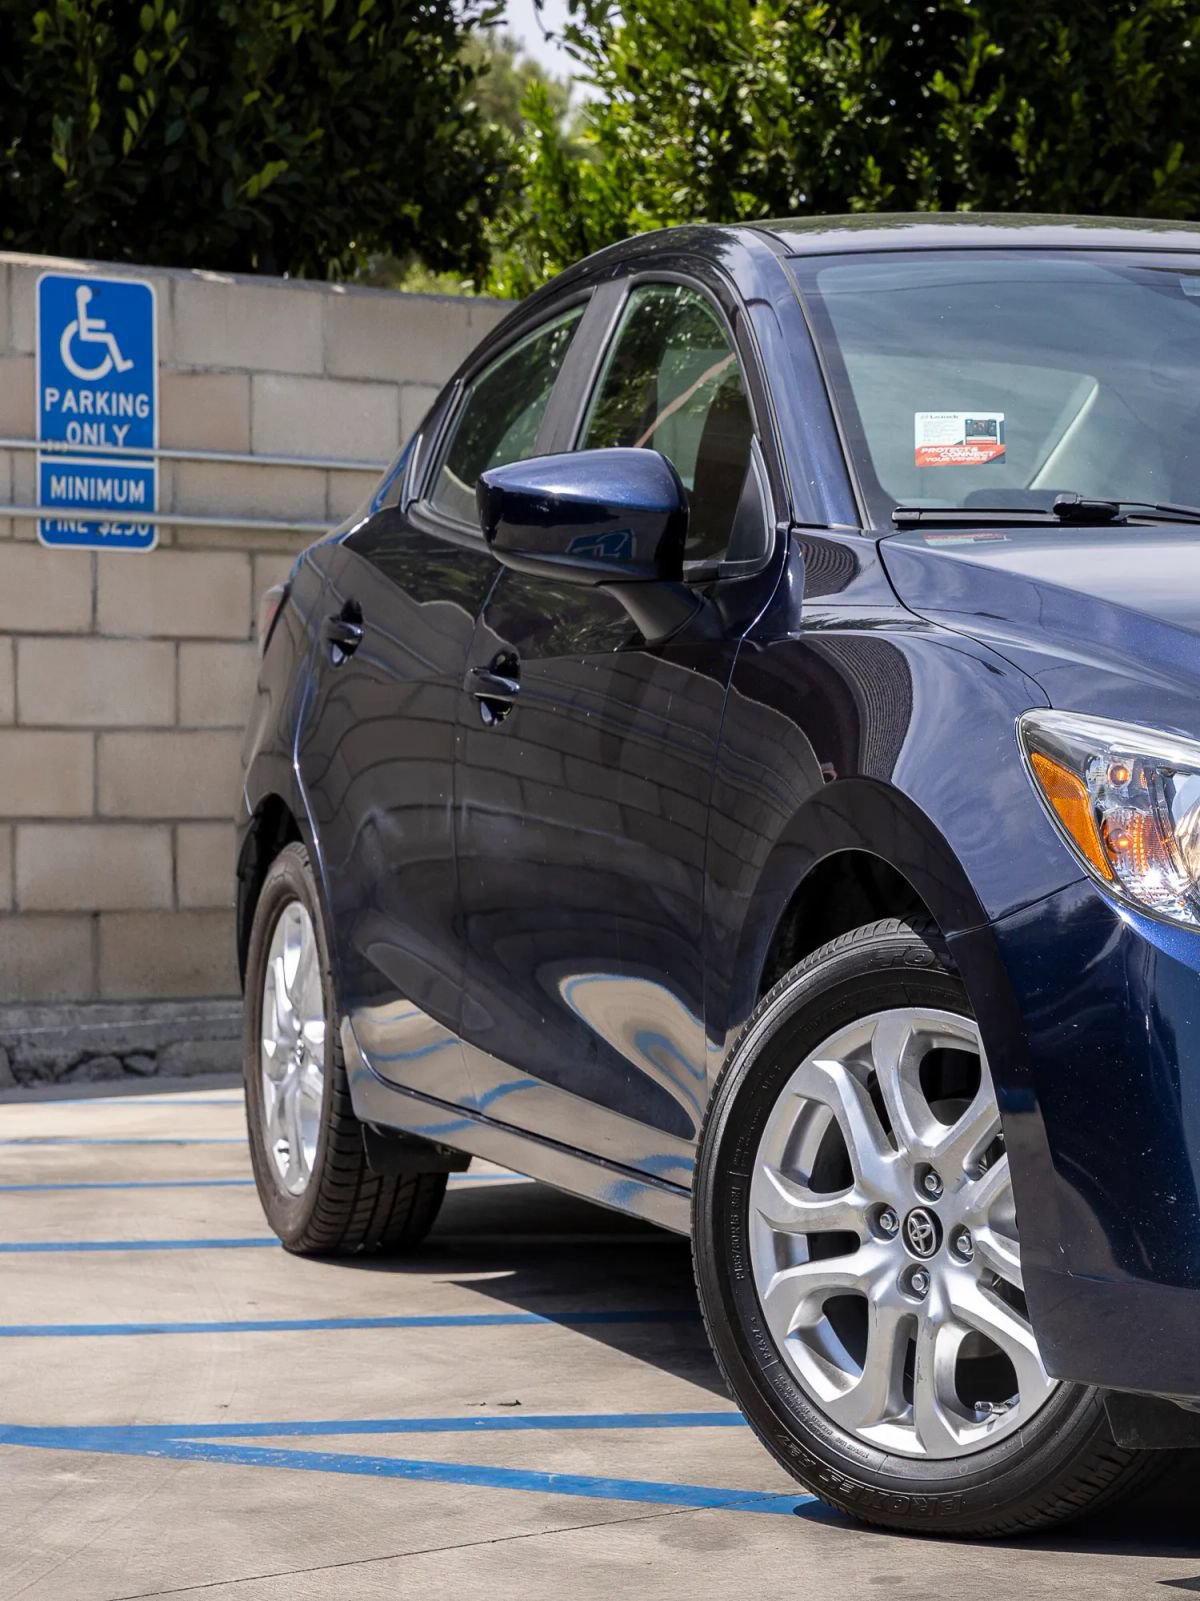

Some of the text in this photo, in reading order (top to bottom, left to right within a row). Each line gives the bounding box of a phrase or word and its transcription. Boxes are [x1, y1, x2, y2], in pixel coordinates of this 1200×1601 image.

[44, 387, 150, 418] PARKING
[66, 421, 131, 447] ONLY
[50, 475, 146, 504] MINIMUM
